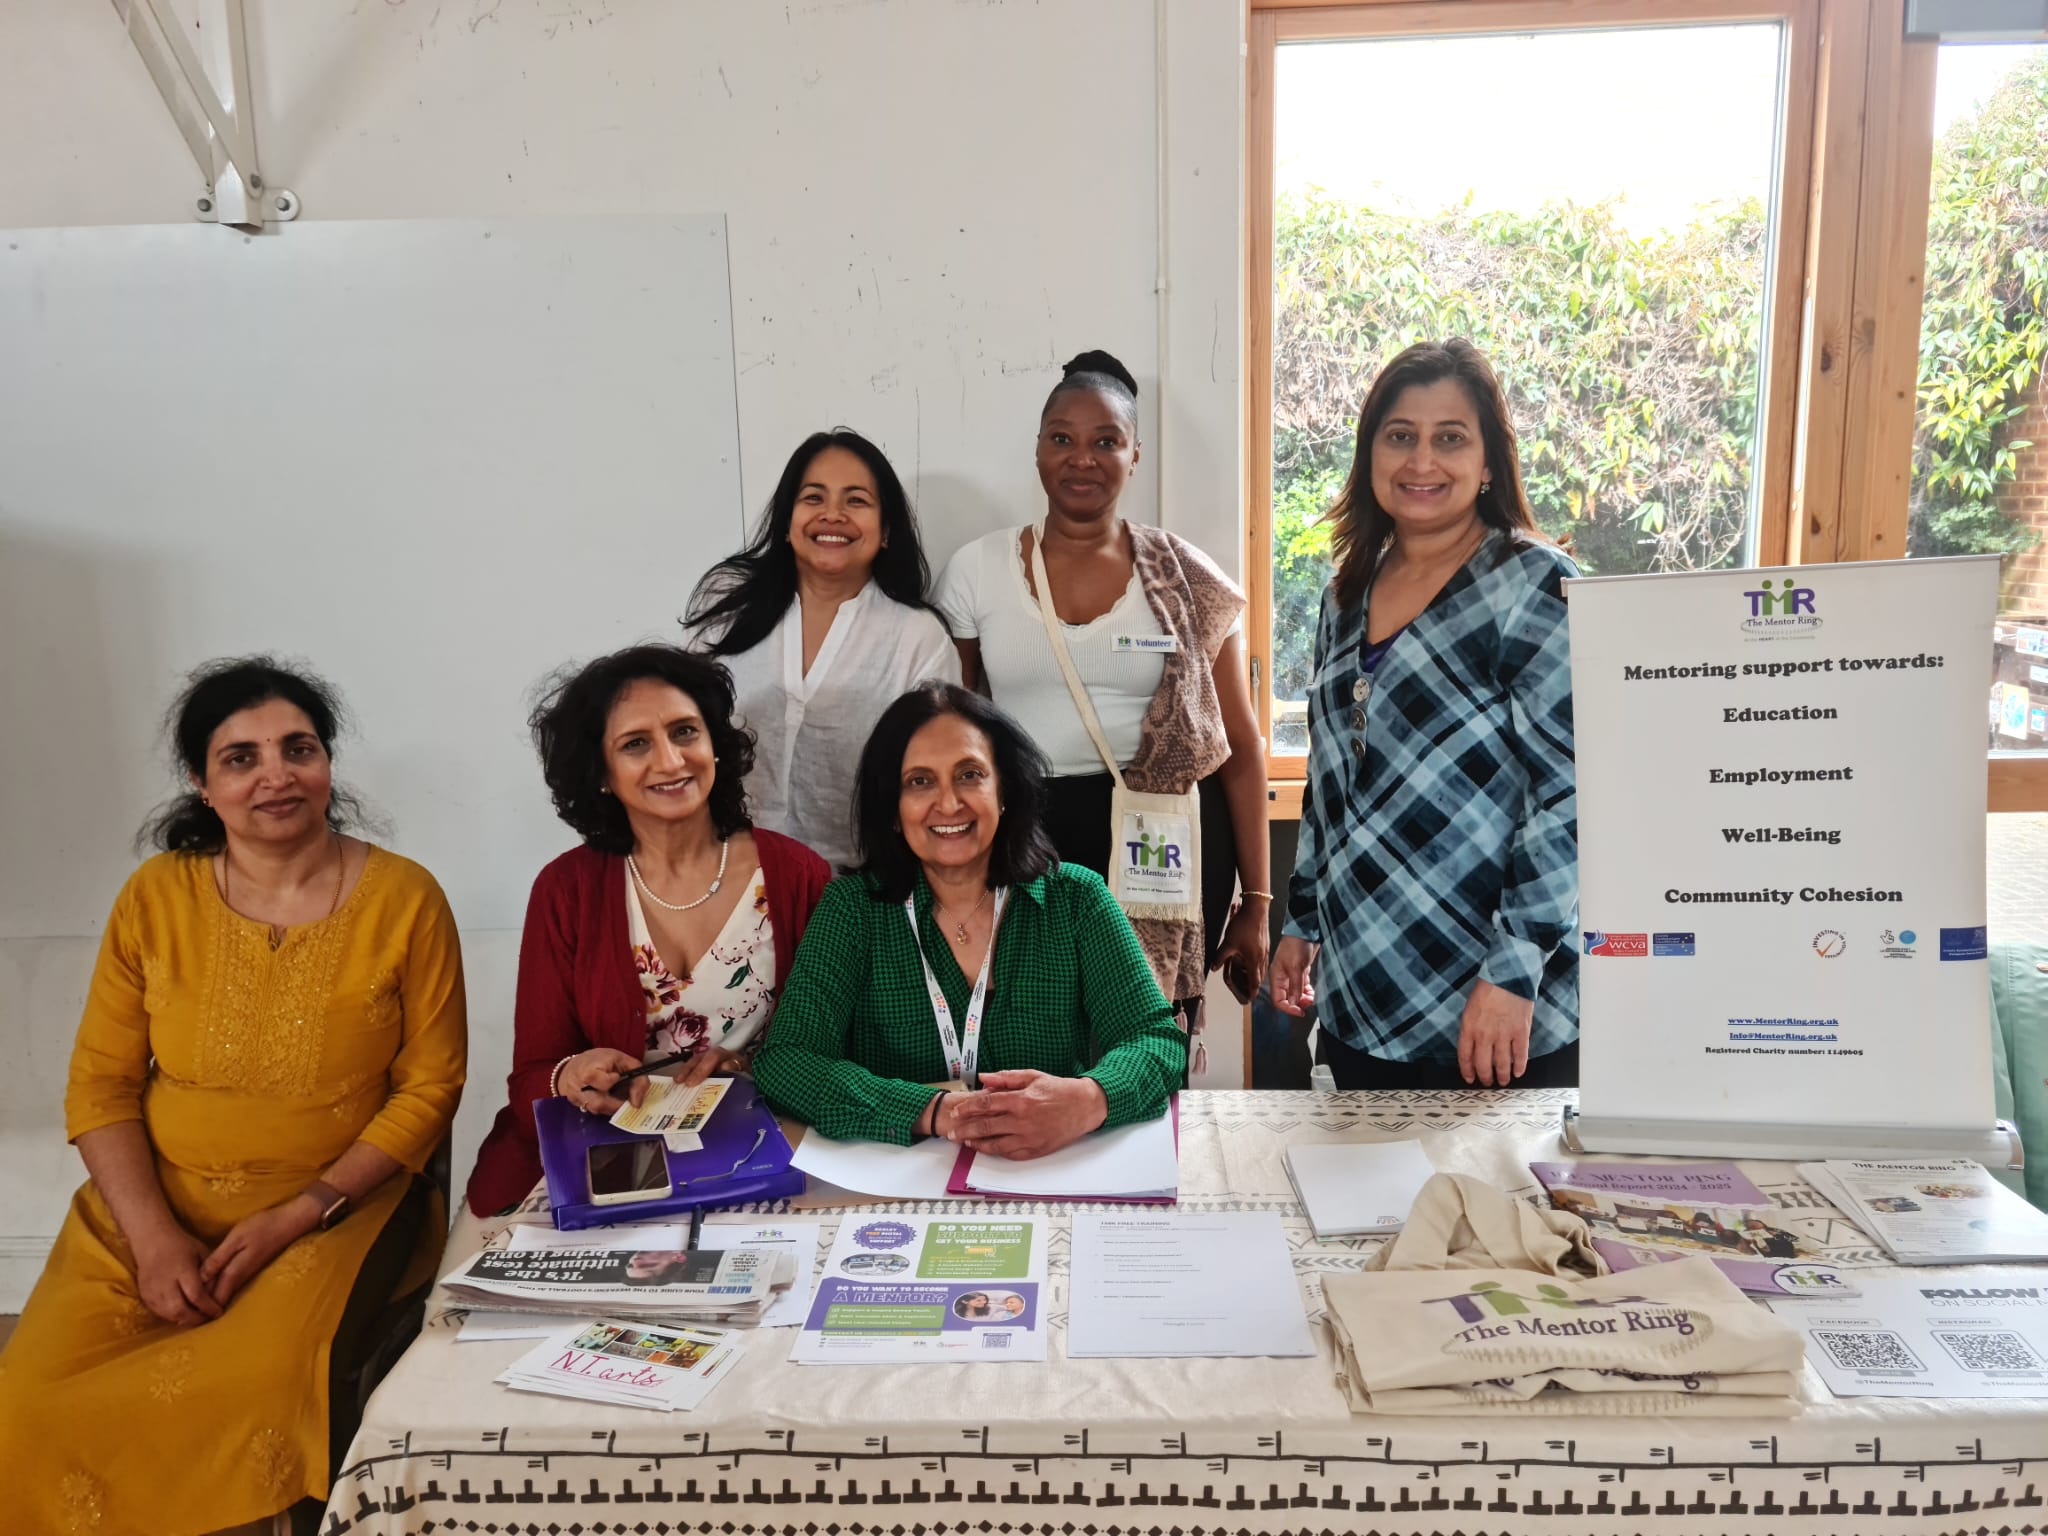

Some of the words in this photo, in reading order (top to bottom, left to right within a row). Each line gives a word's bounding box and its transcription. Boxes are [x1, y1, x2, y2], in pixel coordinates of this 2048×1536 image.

[1746, 618, 1763, 627] The
[1765, 617, 1796, 626] Mentor
[1797, 615, 1819, 627] Ring
[1135, 638, 1172, 648] Volunteer
[1623, 662, 1738, 680] Mentoring
[1742, 657, 1834, 677] support
[1839, 653, 1945, 672] towards:
[1723, 705, 1838, 723] Education
[1708, 766, 1854, 785] Employment
[1721, 827, 1842, 845] Well-Being
[1128, 867, 1141, 875] The
[1141, 868, 1168, 878] Mentor
[1664, 888, 1794, 906] Community
[1799, 887, 1904, 902] Cohesion
[1812, 929, 1839, 948] INVESTING
[1727, 1017, 1840, 1027] www.MentorRing.org.uk
[1729, 1032, 1838, 1042] Info@MentorRing.org.uk
[1752, 1047, 1786, 1056] Charity
[1876, 1163, 1926, 1171] MENTOR
[1591, 1173, 1675, 1183] MENTOR
[1684, 1173, 1732, 1183] RING
[1610, 1182, 1652, 1191] Report
[1656, 1183, 1688, 1191] 2024
[1700, 1183, 1732, 1191] 2025
[939, 1224, 957, 1232] DO
[990, 1224, 1023, 1232] NEED
[528, 1250, 543, 1260] it
[549, 1250, 610, 1259] bring
[481, 1259, 525, 1269] test
[528, 1258, 620, 1270] ultimate
[504, 1270, 542, 1279] the
[831, 1291, 848, 1303] A
[852, 1291, 950, 1303] MENTOR?
[1919, 1288, 2040, 1299] FOLLOW
[1931, 1299, 1960, 1307] ON
[1962, 1299, 2034, 1307] SOCIAL
[1455, 1325, 1510, 1343] The
[1514, 1316, 1617, 1337] Mentor
[1621, 1309, 1696, 1336] Ring
